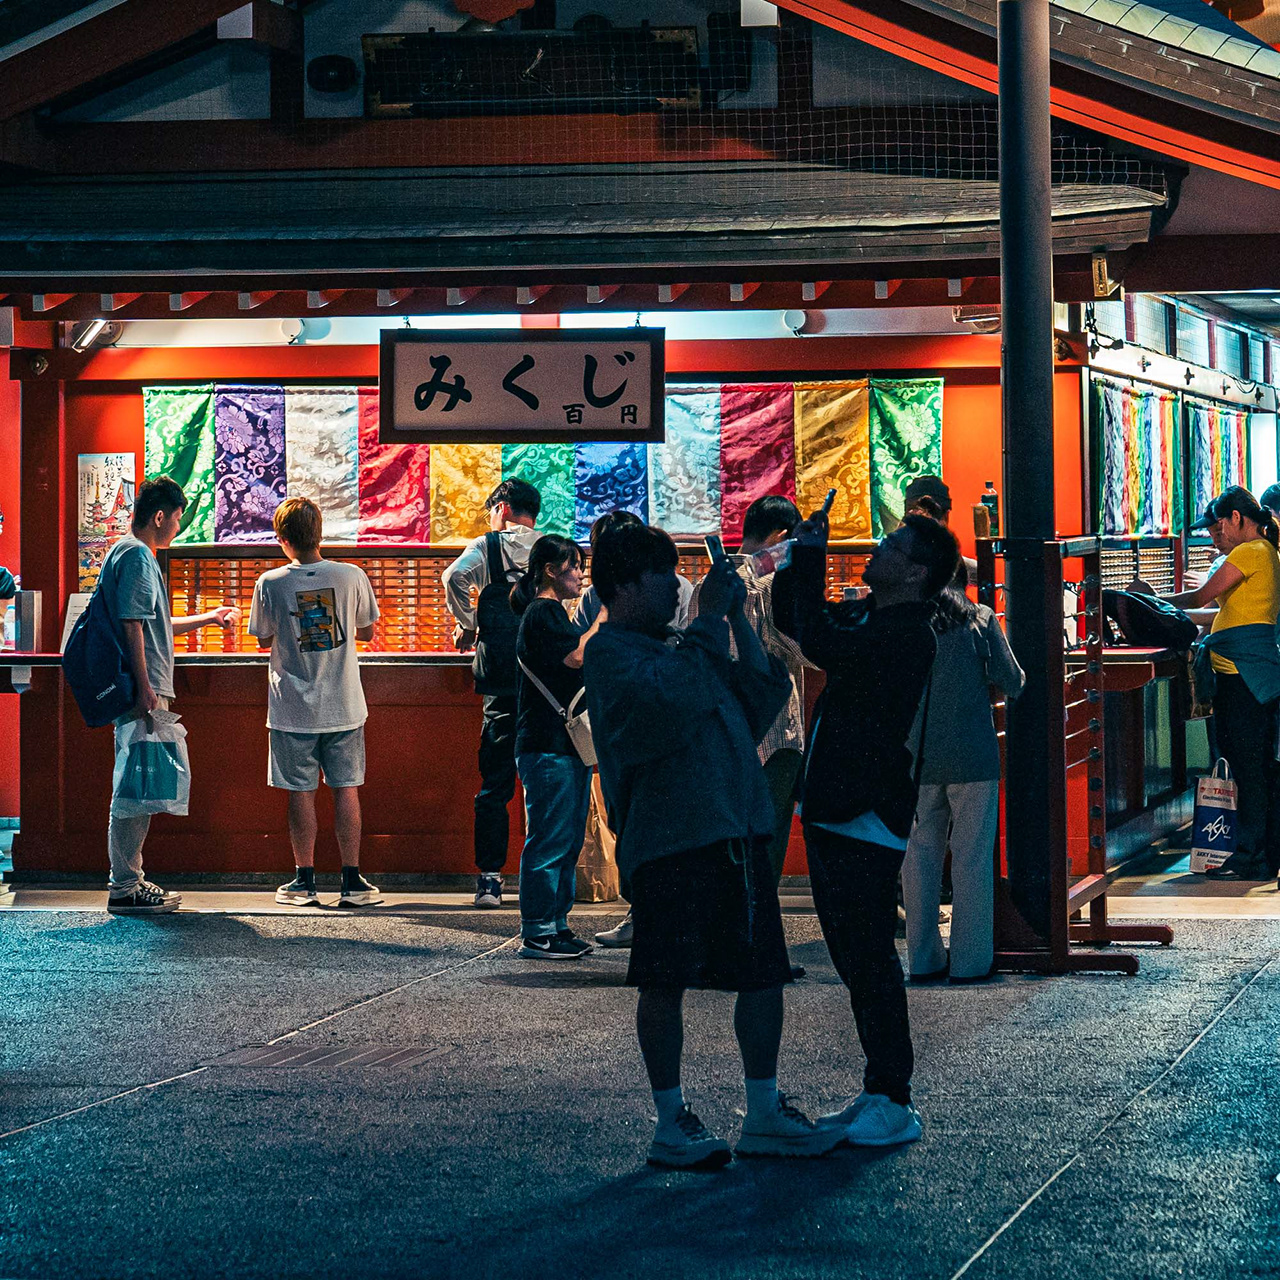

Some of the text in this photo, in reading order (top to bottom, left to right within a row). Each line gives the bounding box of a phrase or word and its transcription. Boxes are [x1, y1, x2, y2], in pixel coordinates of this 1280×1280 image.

[414, 350, 637, 412] みくじ
[563, 403, 638, 425] 百円
